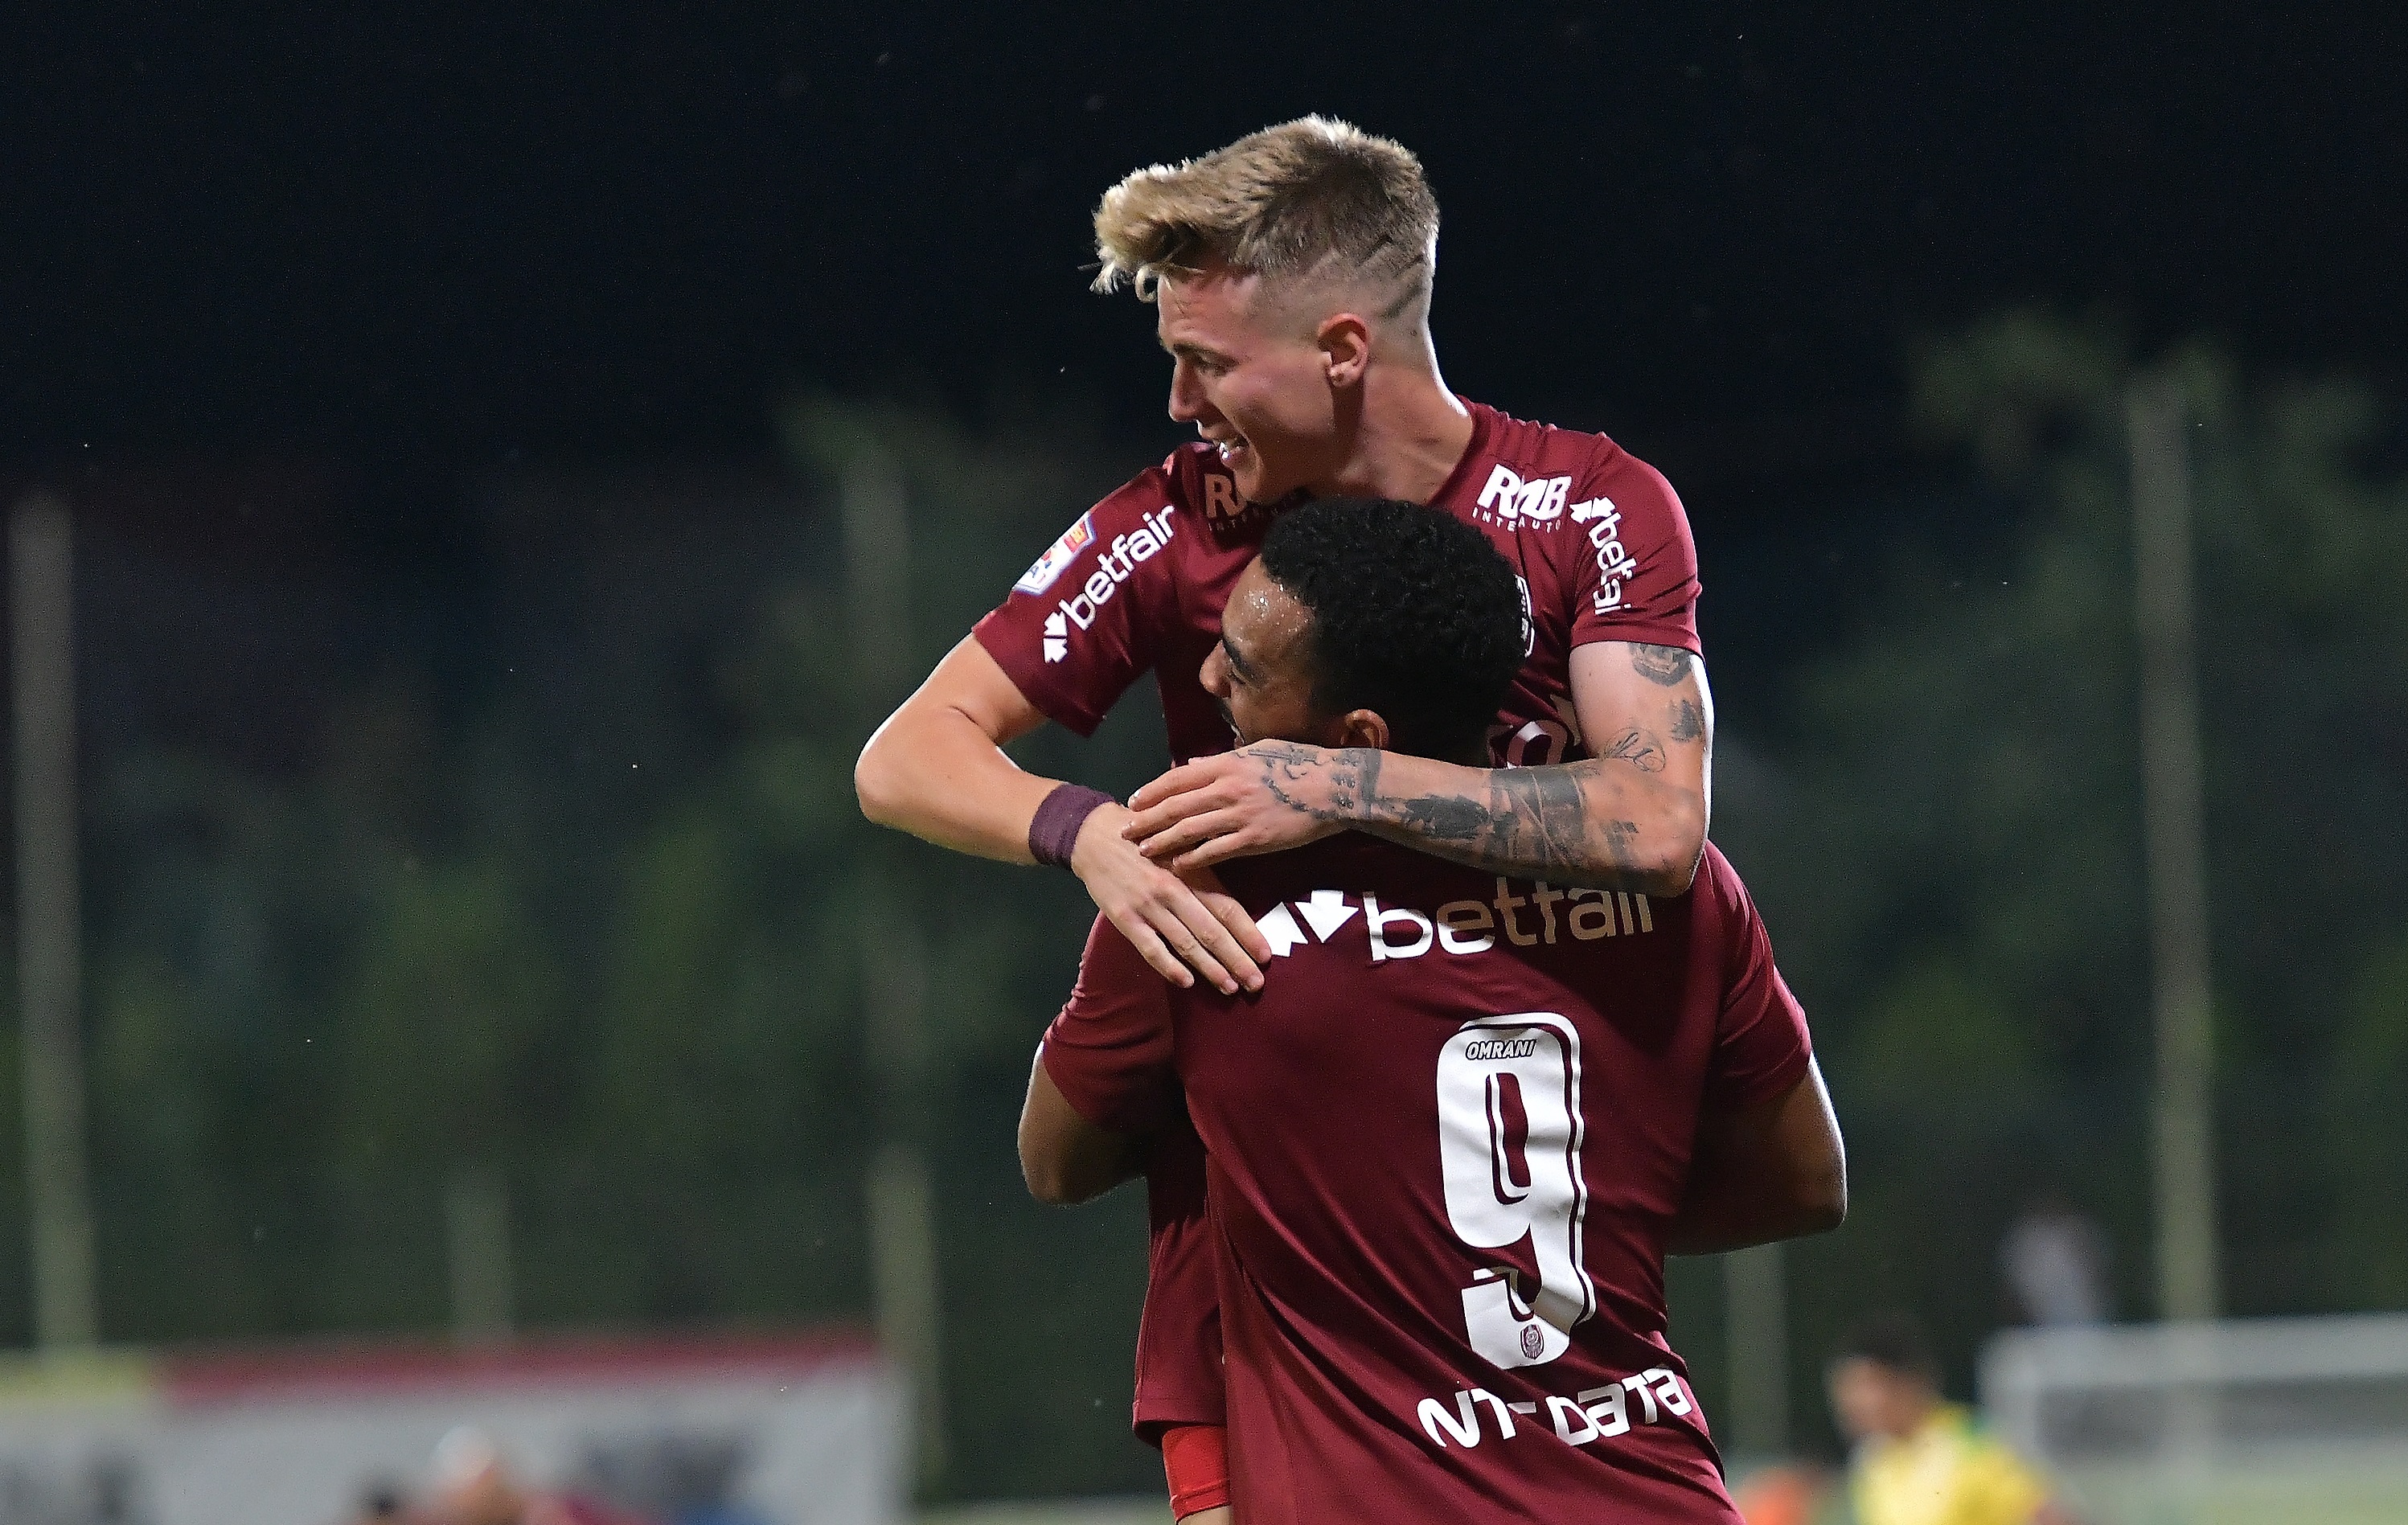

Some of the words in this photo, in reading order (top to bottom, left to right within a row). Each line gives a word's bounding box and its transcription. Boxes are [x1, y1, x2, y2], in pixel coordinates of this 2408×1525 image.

[1059, 505, 1175, 630] betfair
[1466, 1039, 1536, 1060] OMRANI
[1437, 1012, 1598, 1370] 9
